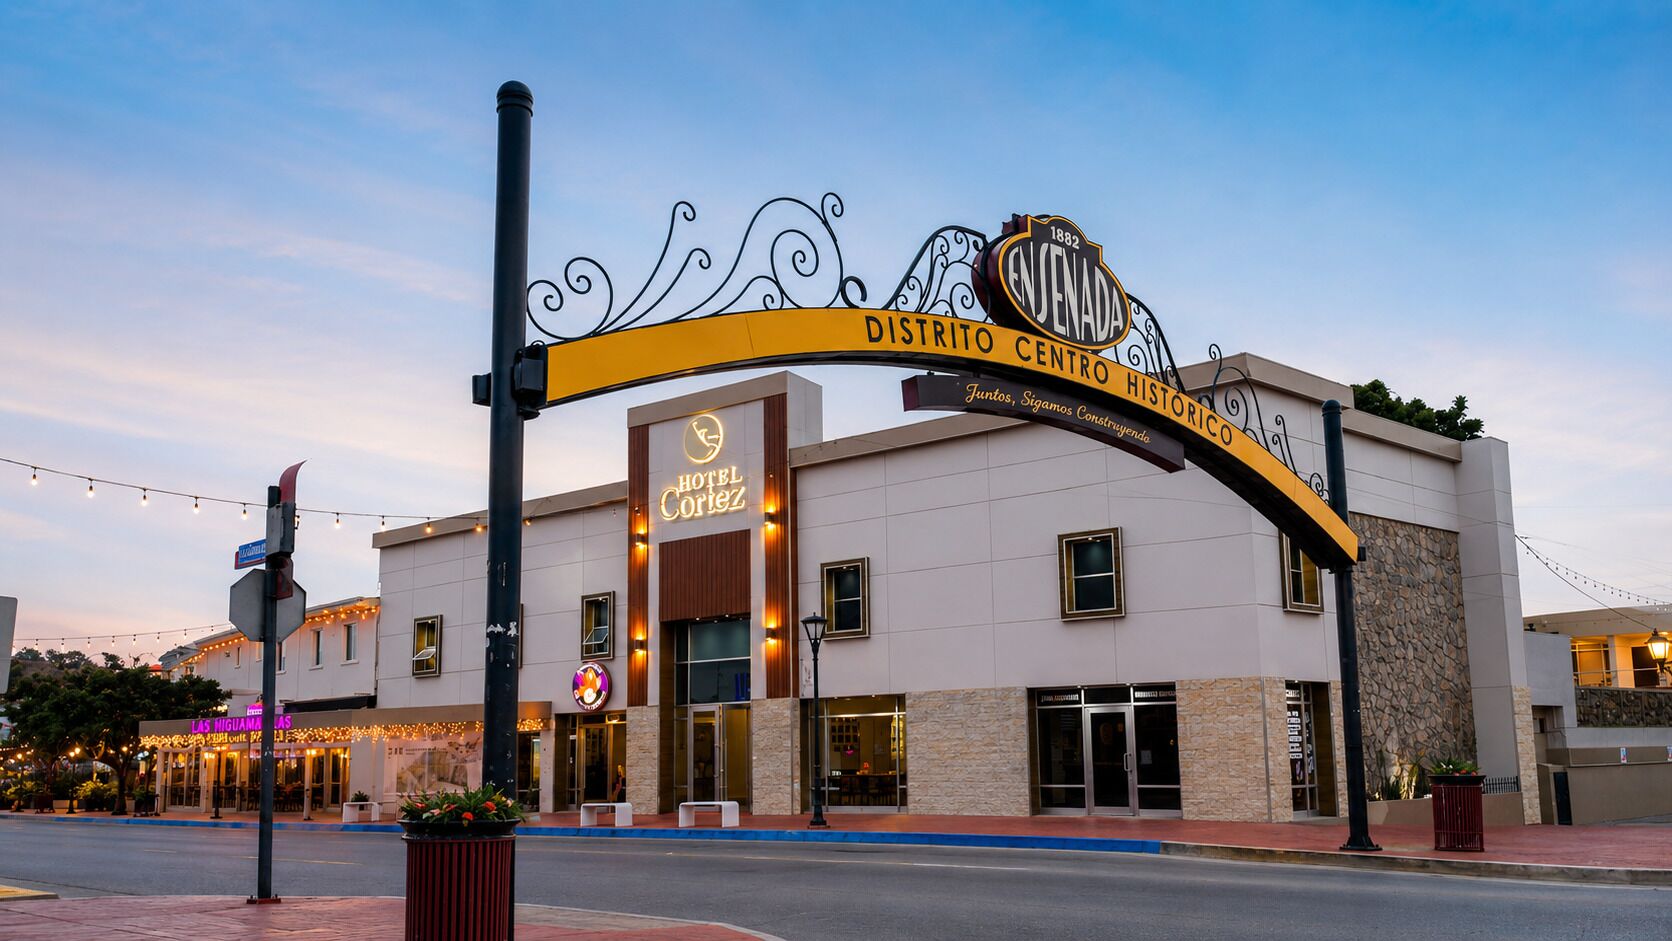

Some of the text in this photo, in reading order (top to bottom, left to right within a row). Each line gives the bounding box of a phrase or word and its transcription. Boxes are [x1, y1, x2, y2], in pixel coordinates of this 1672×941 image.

[1050, 226, 1080, 250] 1882
[1008, 241, 1124, 342] ENSENADA
[865, 315, 1232, 446] DISTRITO CENTRO HISTÓRICO
[965, 383, 1152, 445] Juntos, Sigamos Construyendo
[678, 466, 744, 494] HOTEL
[660, 486, 747, 521] Cortez
[191, 719, 211, 733] LAS
